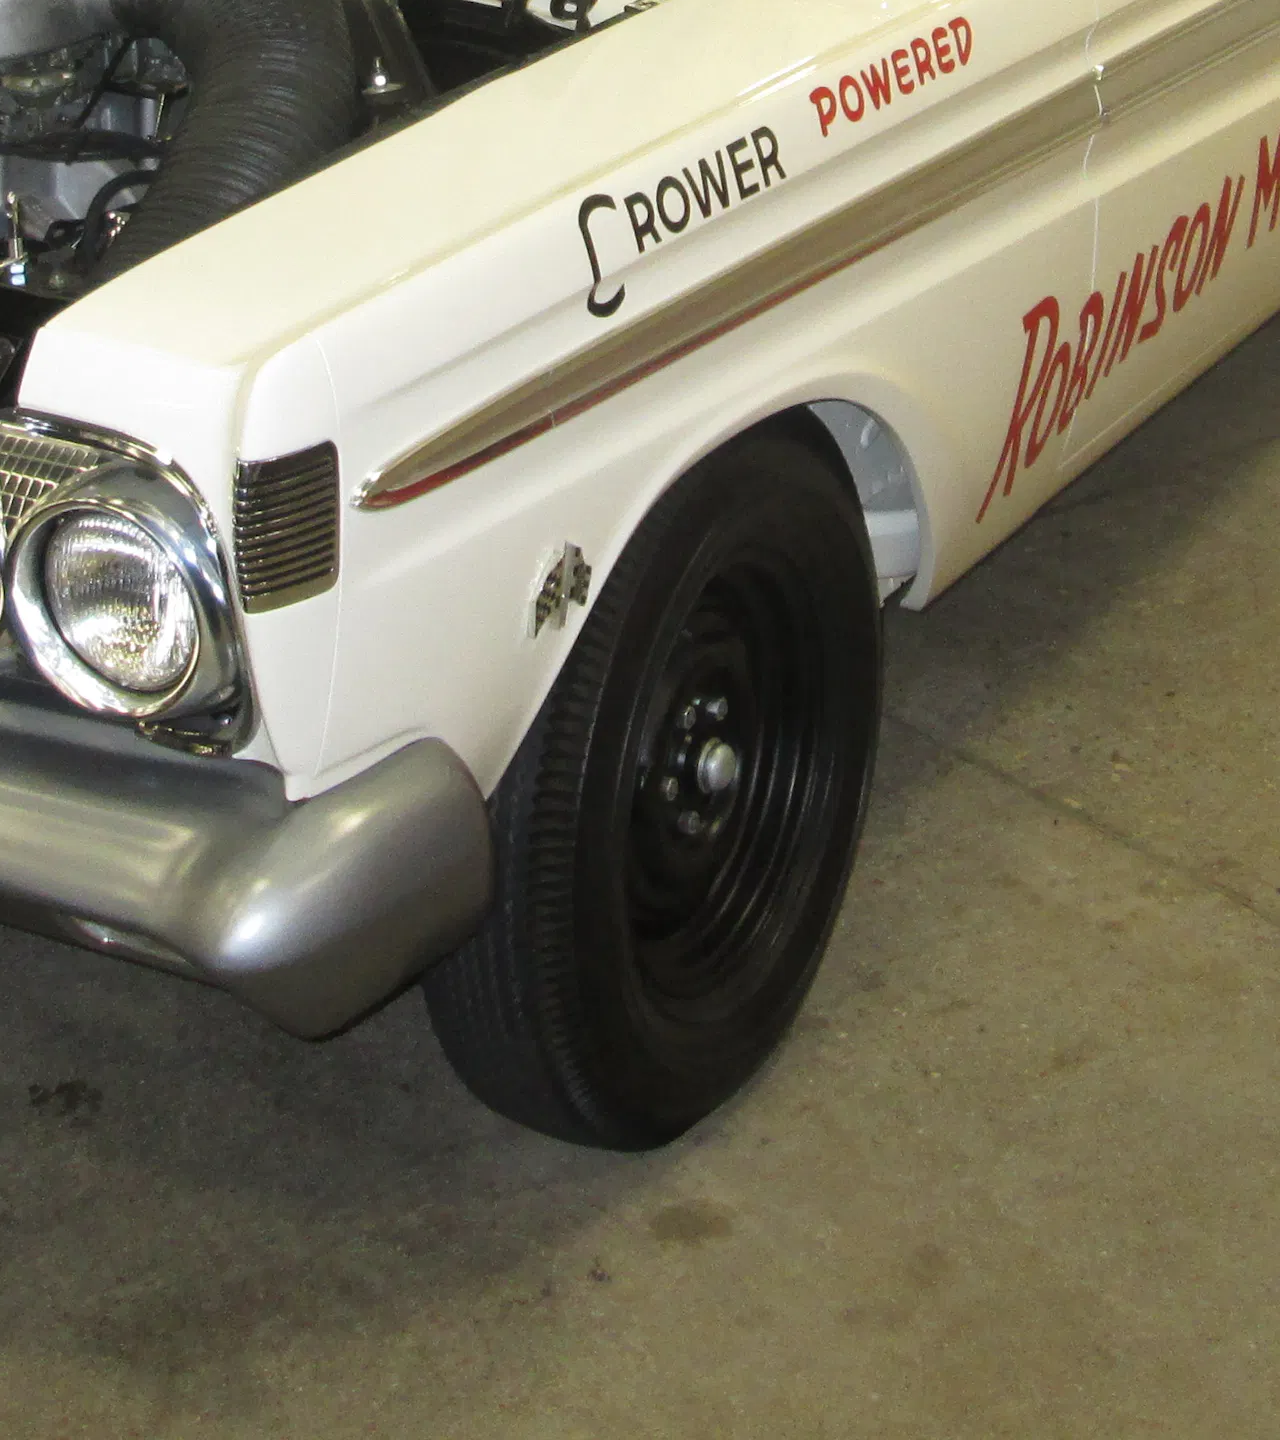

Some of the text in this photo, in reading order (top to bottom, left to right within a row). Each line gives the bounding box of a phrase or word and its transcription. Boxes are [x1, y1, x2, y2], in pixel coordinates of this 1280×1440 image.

[578, 16, 973, 318] CROWER POWERED
[976, 174, 1245, 524] ROBINSON
